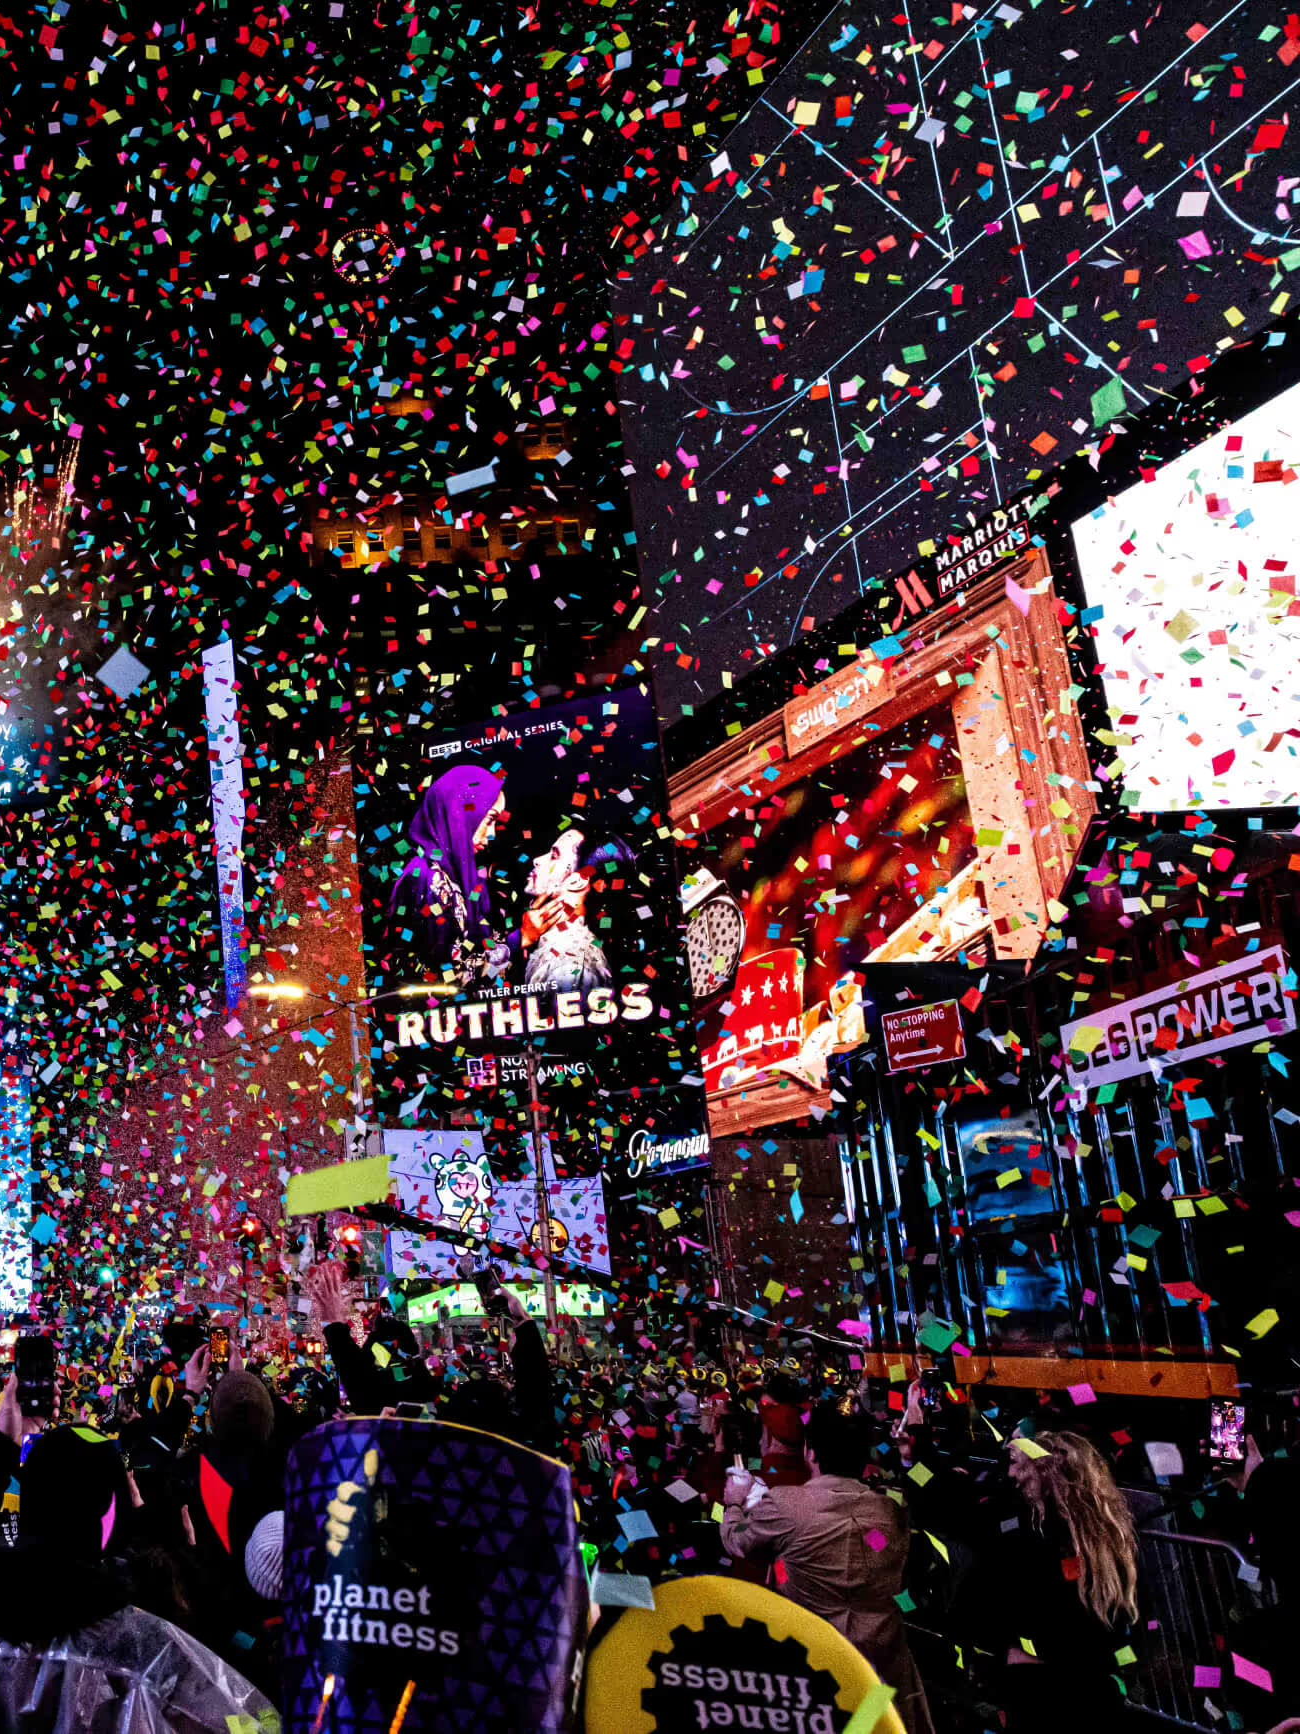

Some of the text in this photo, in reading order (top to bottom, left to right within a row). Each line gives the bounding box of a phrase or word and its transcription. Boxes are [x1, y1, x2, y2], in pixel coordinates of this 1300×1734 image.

[936, 496, 1033, 571] MARRIOTT
[940, 527, 1026, 593] MARQUIS
[478, 981, 558, 999] TYLER PERRY'S
[398, 983, 653, 1047] RUTHLESS
[887, 1018, 899, 1030] NO
[890, 1028, 926, 1043] Anytime
[1135, 971, 1283, 1057] POWER
[312, 1574, 431, 1616] planet
[322, 1608, 459, 1655] fitness
[660, 1662, 811, 1709] fitness
[694, 1699, 834, 1734] planet
